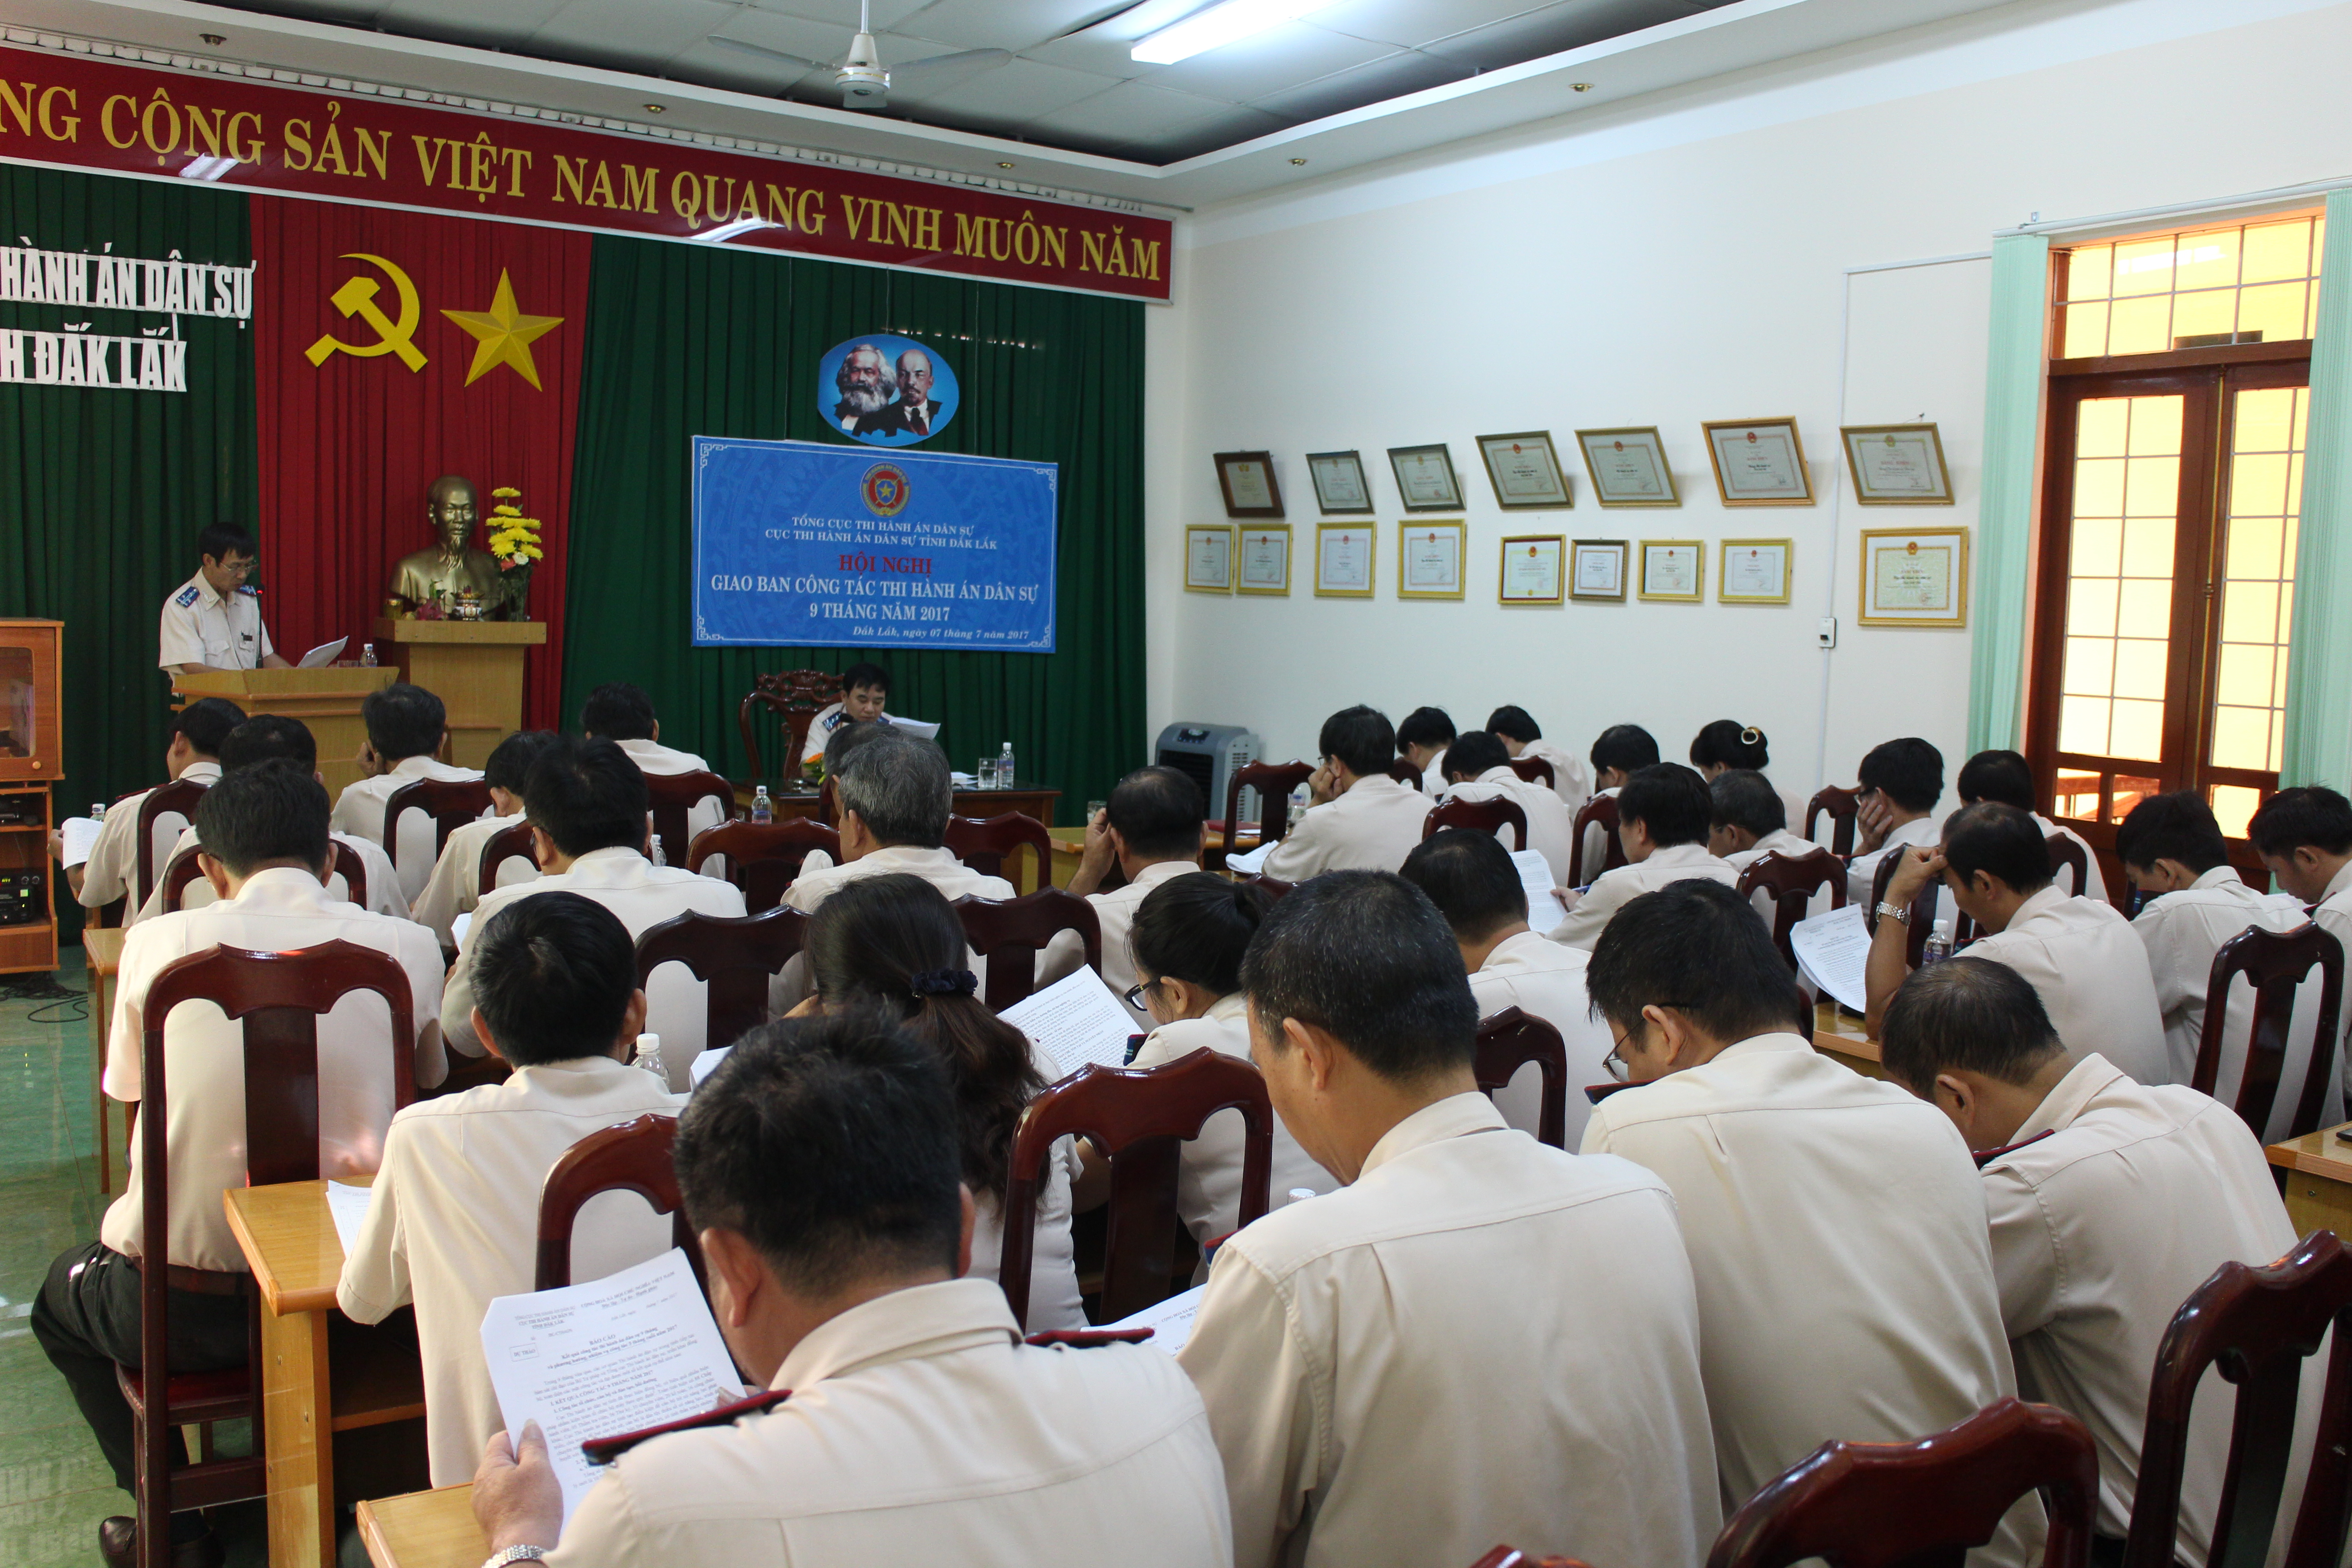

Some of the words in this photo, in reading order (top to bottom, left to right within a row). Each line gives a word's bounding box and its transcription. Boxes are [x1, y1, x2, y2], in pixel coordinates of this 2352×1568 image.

[100, 88, 266, 166] CỘNG
[284, 102, 392, 181] SẢN
[412, 132, 532, 203] VIỆT
[552, 154, 660, 214] NAM
[671, 171, 826, 236] QUANG
[840, 195, 942, 252] VINH
[953, 210, 1068, 268] MUÔN
[1079, 224, 1161, 281] NĂM
[0, 236, 87, 306] HÀNH
[96, 242, 136, 310] ÁN
[145, 250, 206, 315] DÂN
[214, 260, 257, 329] SỰ
[34, 322, 110, 388] ĐẮK
[120, 327, 187, 392] LẮK
[765, 529, 790, 540] CỤC
[794, 530, 814, 540] THI
[818, 530, 851, 542] HÀNH
[854, 531, 871, 543] ÁN
[875, 533, 898, 544] DÂN
[901, 535, 916, 547] SỰ
[919, 534, 946, 547] TỈNH
[975, 536, 997, 549] LẮK
[792, 513, 824, 528] TỔNG
[828, 519, 852, 530] CỤC
[855, 520, 875, 530] THI
[879, 520, 911, 532] HÀNH
[914, 522, 930, 533] ÁN
[933, 523, 956, 534] DÂN
[959, 525, 975, 538] SỰ
[838, 551, 876, 575] HỘI
[882, 557, 931, 578] NGHỊ
[711, 575, 752, 591] GIAO
[757, 576, 790, 592] BAN
[795, 574, 840, 594] CÔNG
[845, 576, 875, 596] TÁC
[880, 581, 906, 597] THI
[911, 579, 955, 598] HÀNH
[959, 580, 980, 599] ÁN
[984, 581, 1015, 600] DÂN
[1019, 584, 1039, 604] SỰ
[810, 603, 817, 617] 9
[822, 599, 877, 619] THÁNG
[881, 602, 916, 621] NĂM
[921, 607, 950, 621] 2017
[903, 628, 927, 639] ngày
[930, 628, 941, 637] 07
[944, 628, 972, 640] tháng
[976, 630, 982, 638] 7
[984, 630, 1005, 639] năm
[1007, 630, 1029, 640] 2017
